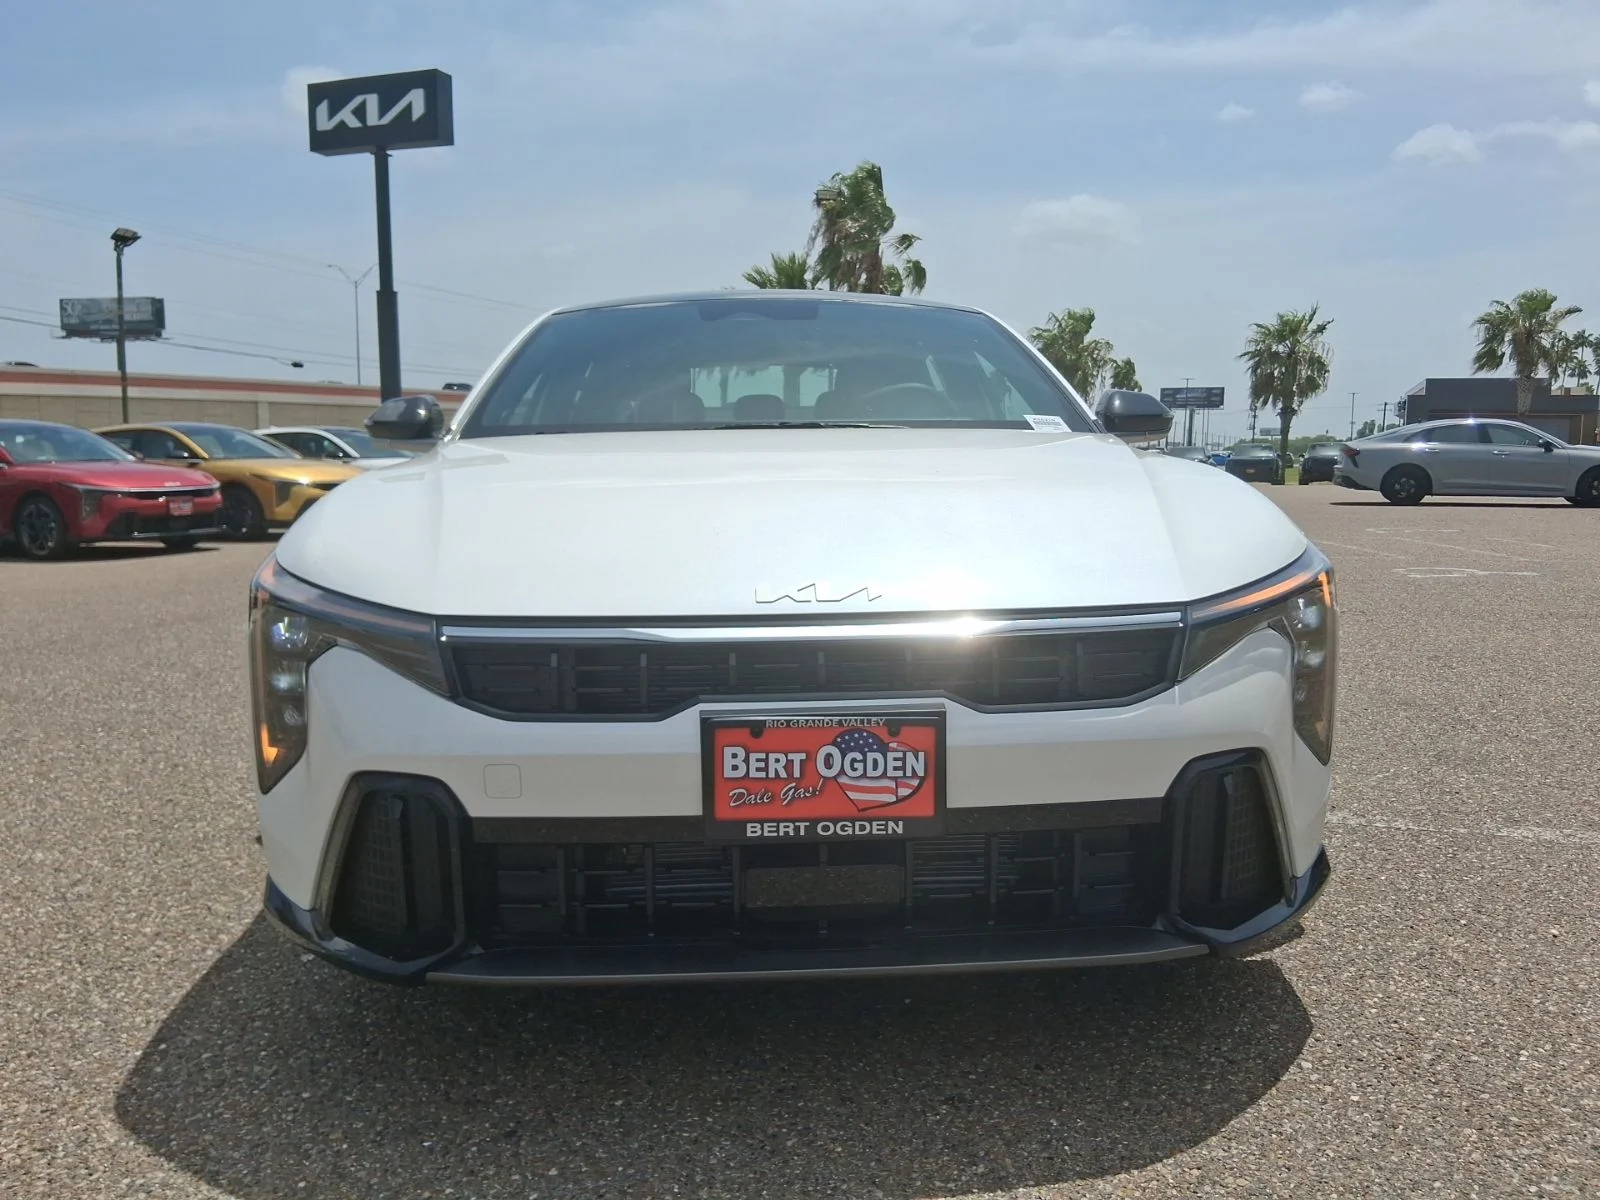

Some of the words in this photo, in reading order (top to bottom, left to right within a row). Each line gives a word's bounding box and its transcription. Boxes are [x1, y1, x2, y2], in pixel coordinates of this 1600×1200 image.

[316, 88, 425, 131] KIA
[765, 719, 787, 728] RIO
[789, 718, 839, 728] GRANDE
[842, 717, 886, 728] VALLEY
[723, 746, 806, 779] BERT
[816, 745, 925, 778] OGDEN
[729, 788, 772, 807] Dale
[780, 778, 824, 806] Gas!
[746, 822, 810, 837] BERT
[816, 821, 904, 836] OGDEN
